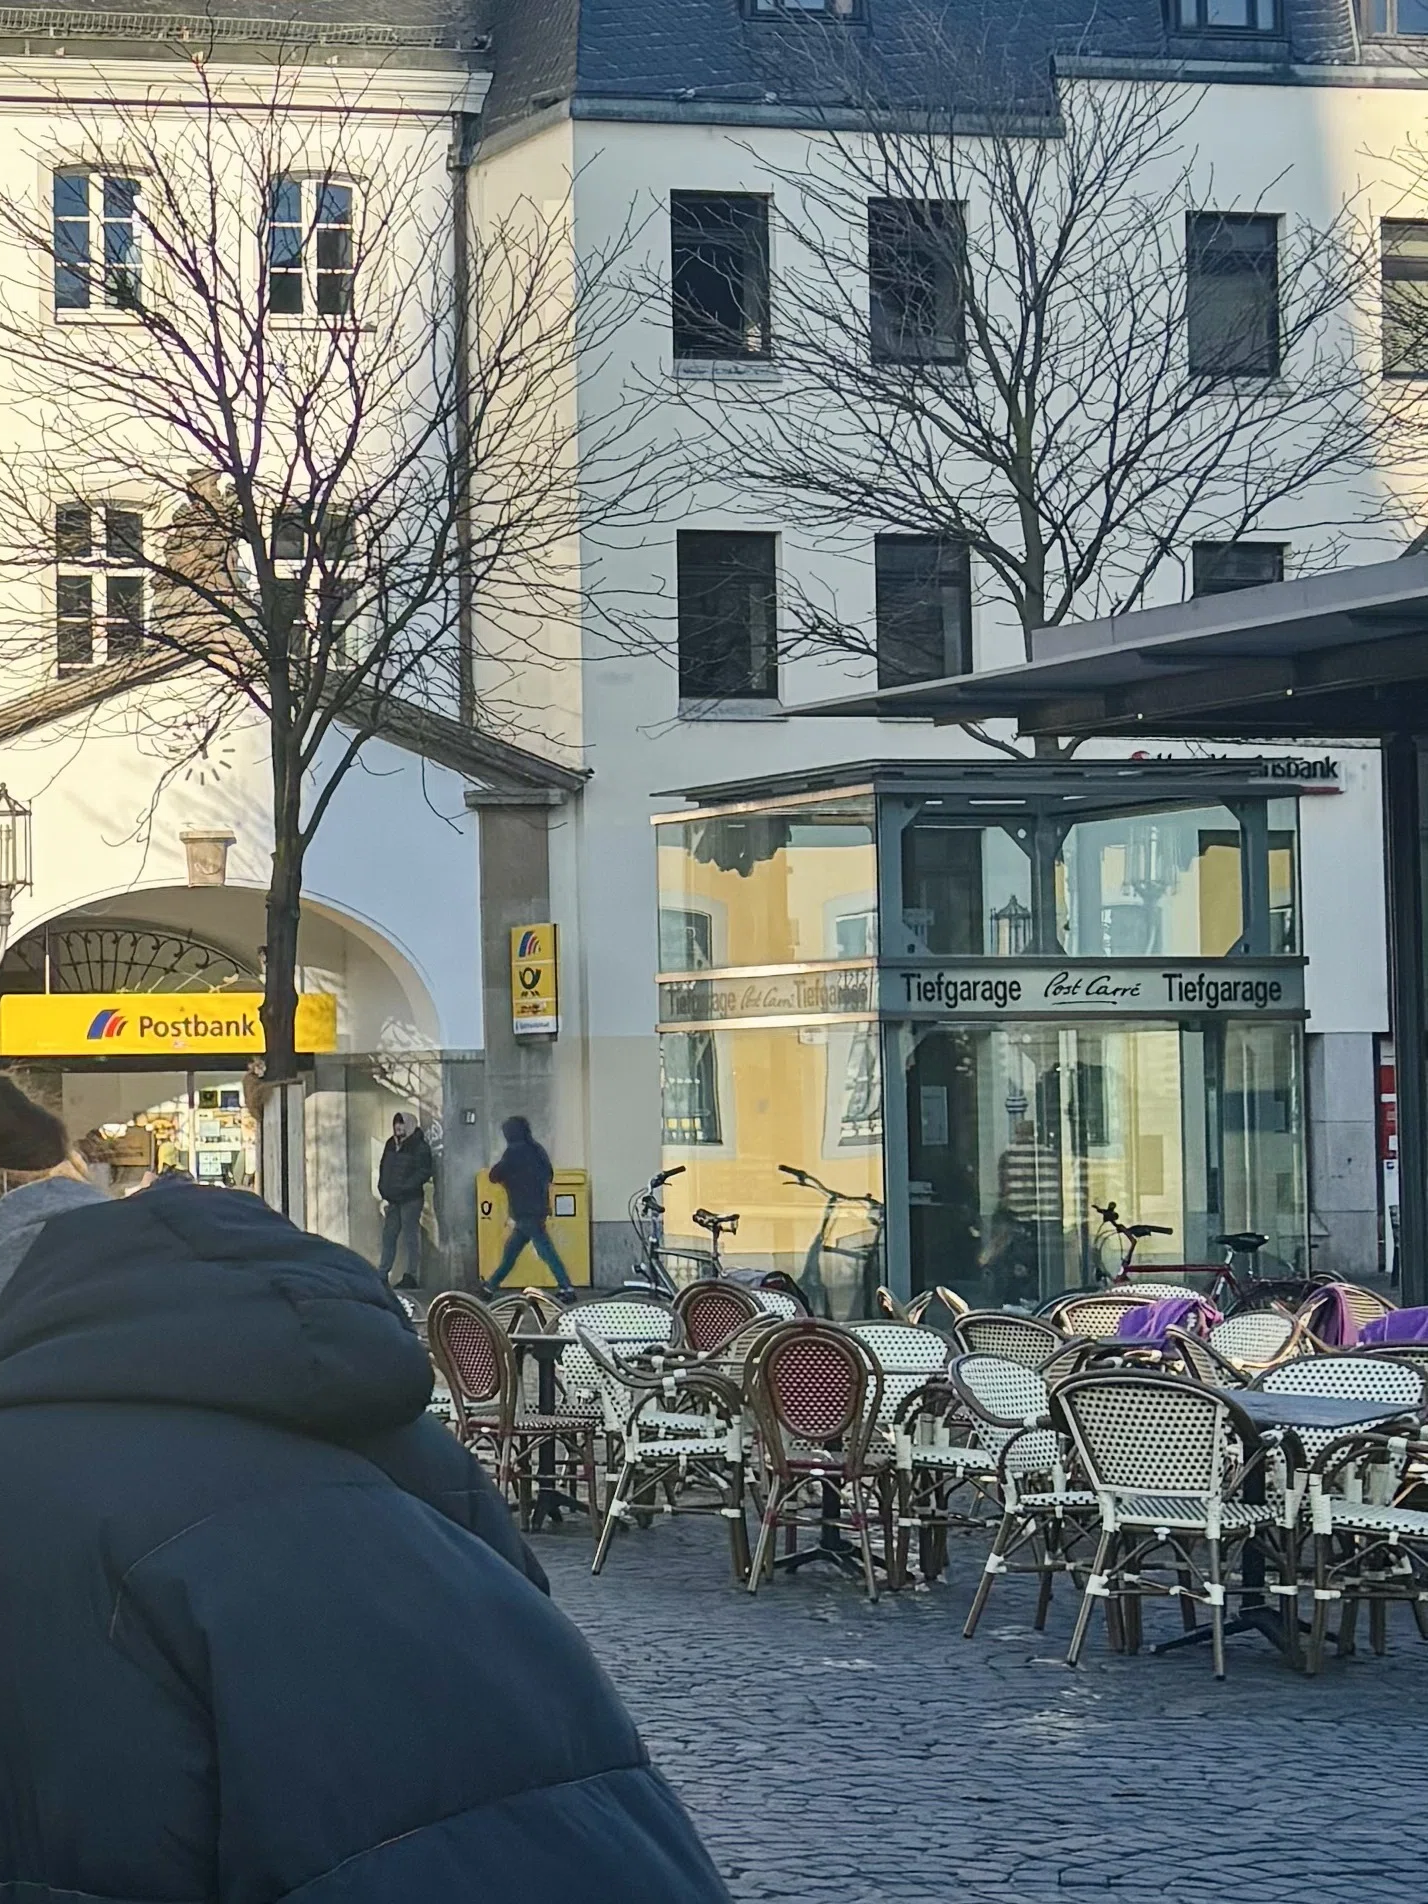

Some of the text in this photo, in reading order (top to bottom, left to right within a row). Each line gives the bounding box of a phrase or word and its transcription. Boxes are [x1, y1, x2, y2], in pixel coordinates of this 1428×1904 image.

[900, 970, 1283, 1009] Tiefgarage Post Carré Tiefgarage
[139, 1012, 256, 1038] Postbank
